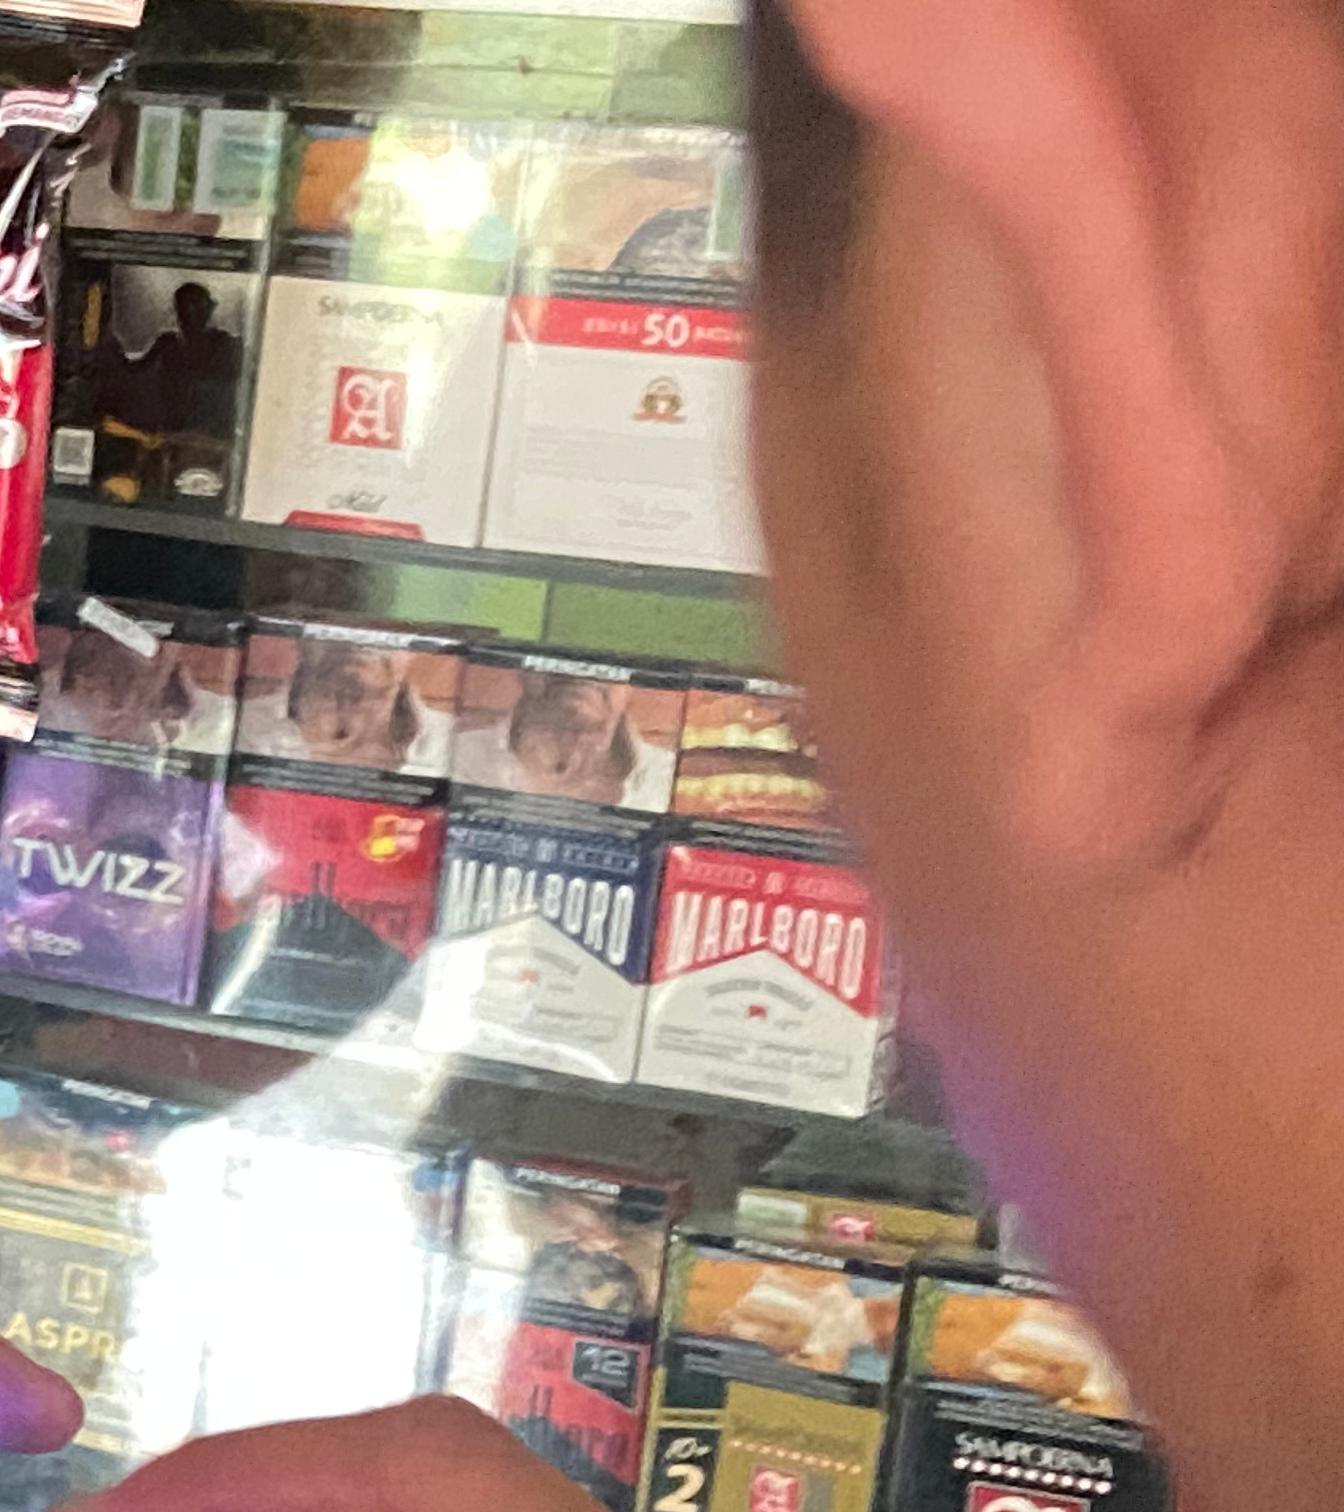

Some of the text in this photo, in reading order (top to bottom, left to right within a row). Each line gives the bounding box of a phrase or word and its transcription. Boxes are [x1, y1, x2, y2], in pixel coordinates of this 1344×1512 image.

[641, 312, 692, 348] 50
[13, 836, 185, 906] TWIZZ
[440, 856, 636, 967] MARLBORO
[665, 888, 868, 1002] MARLBORO
